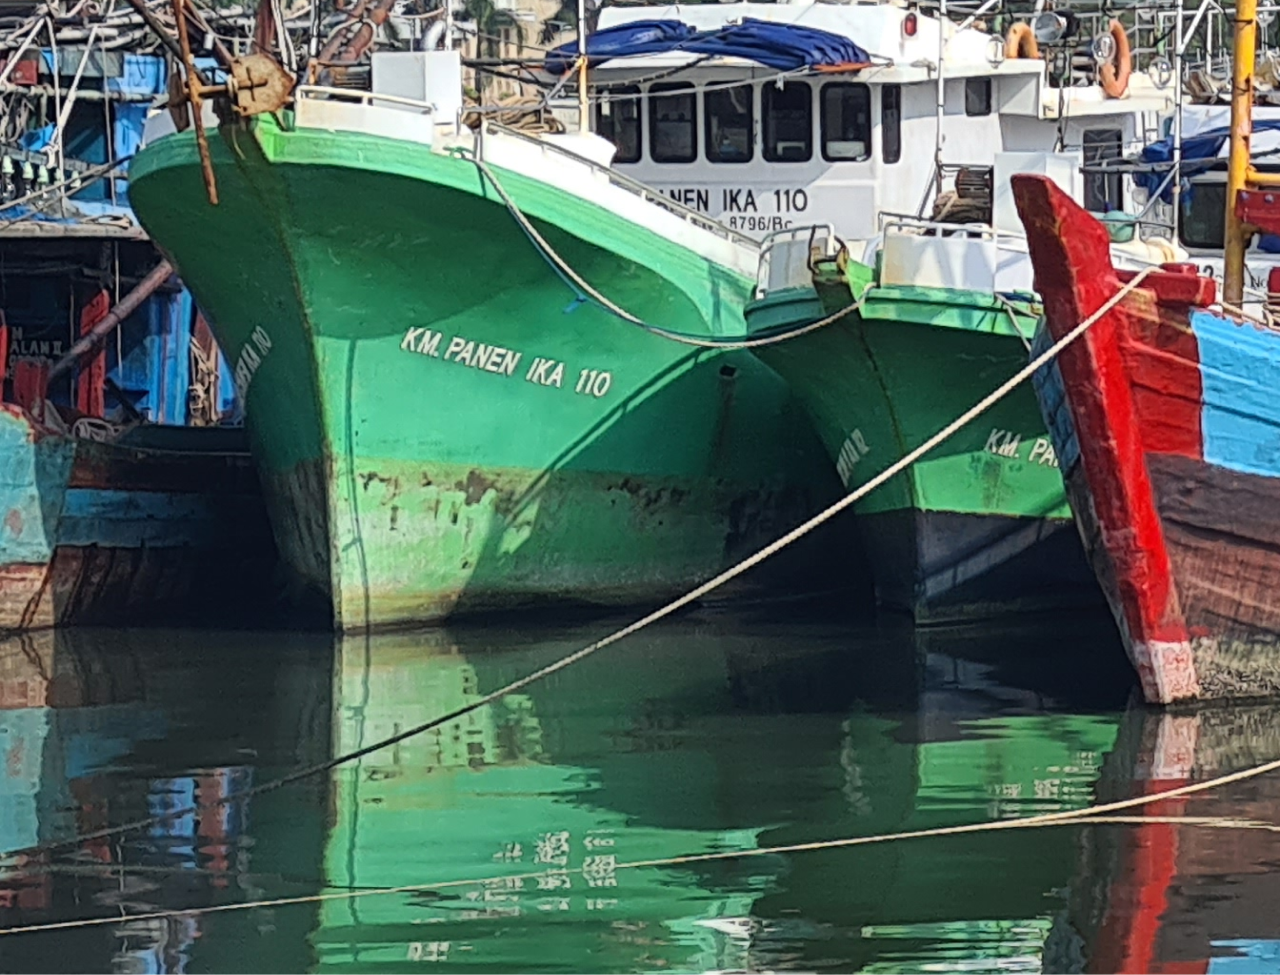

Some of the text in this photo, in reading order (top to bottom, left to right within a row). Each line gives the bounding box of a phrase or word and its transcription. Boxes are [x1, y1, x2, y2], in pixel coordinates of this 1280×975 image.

[723, 189, 758, 213] IKA
[773, 188, 808, 213] 110
[401, 327, 611, 397] KM. PANEN IKA 110
[983, 428, 1059, 467] KM. PA
